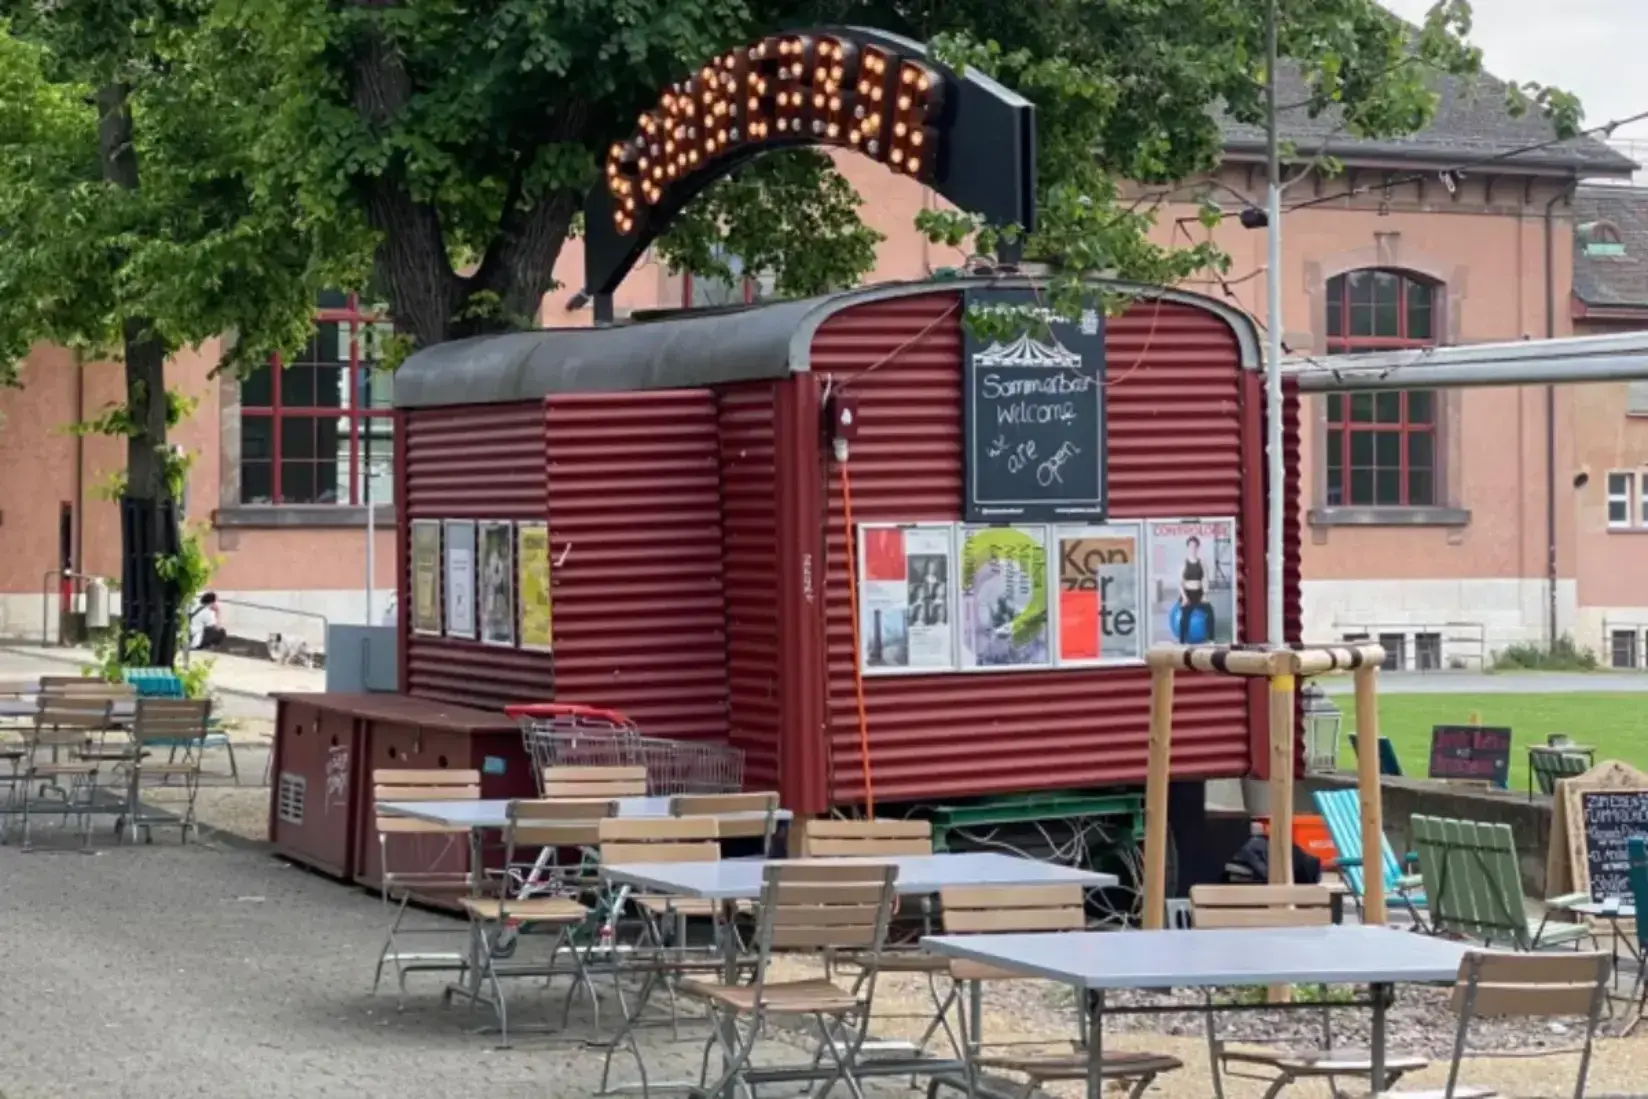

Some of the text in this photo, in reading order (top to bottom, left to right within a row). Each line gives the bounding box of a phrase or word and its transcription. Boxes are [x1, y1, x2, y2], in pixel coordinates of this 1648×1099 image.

[1008, 439, 1037, 474] are
[1060, 539, 1128, 575] Kon
[1098, 604, 1136, 636] te
